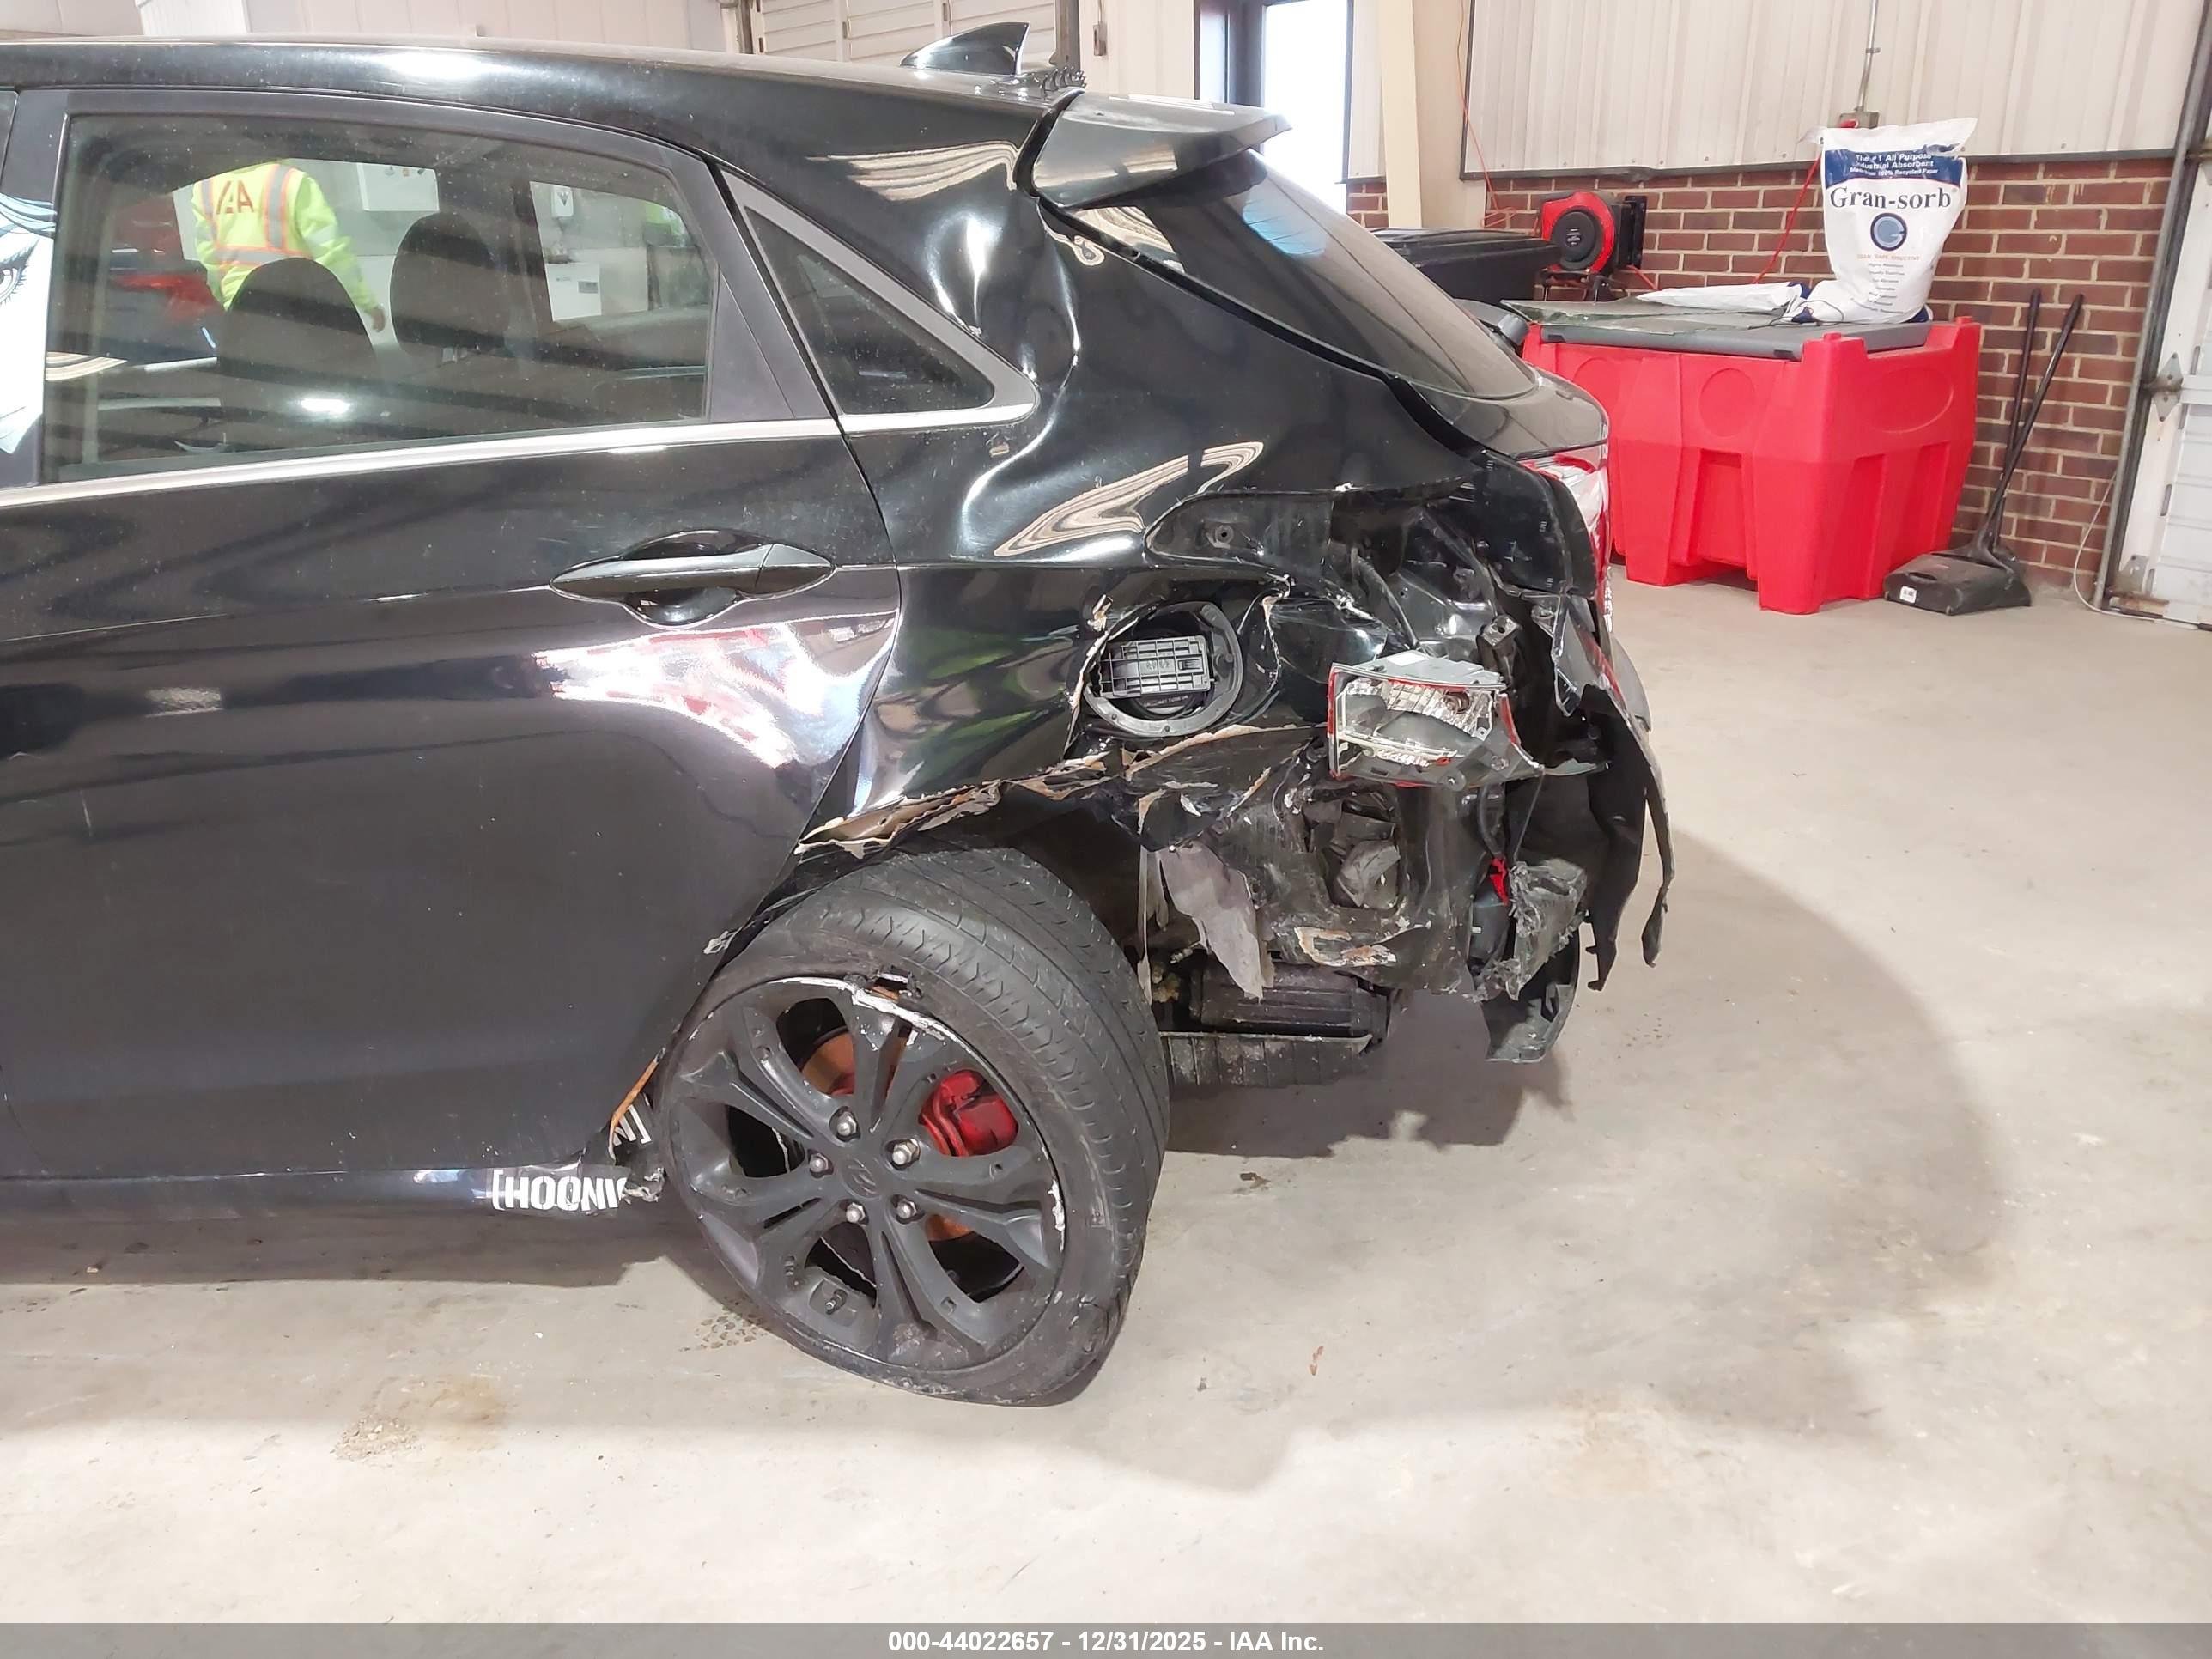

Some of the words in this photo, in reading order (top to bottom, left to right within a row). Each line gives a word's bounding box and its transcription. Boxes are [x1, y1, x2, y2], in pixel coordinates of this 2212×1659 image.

[1856, 154, 1869, 162] The
[1886, 153, 1897, 161] All
[1892, 161, 1935, 169] Absorbent
[1830, 186, 1952, 210] Gran-sorb
